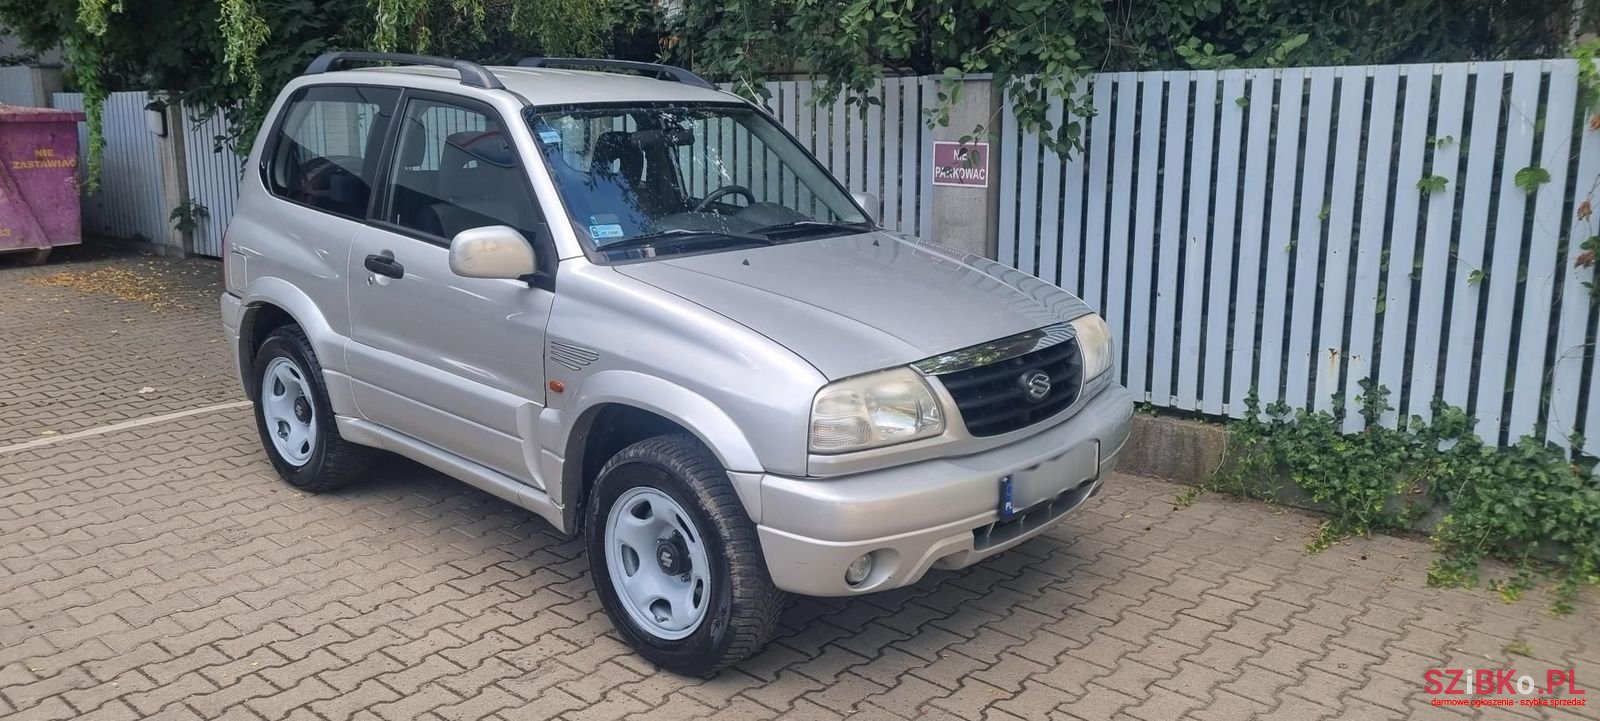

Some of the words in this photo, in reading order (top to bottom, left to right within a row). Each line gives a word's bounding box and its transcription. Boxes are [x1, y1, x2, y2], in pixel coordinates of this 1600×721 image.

[34, 149, 54, 157] NIE
[953, 149, 968, 160] NE
[1005, 502, 1012, 511] PL
